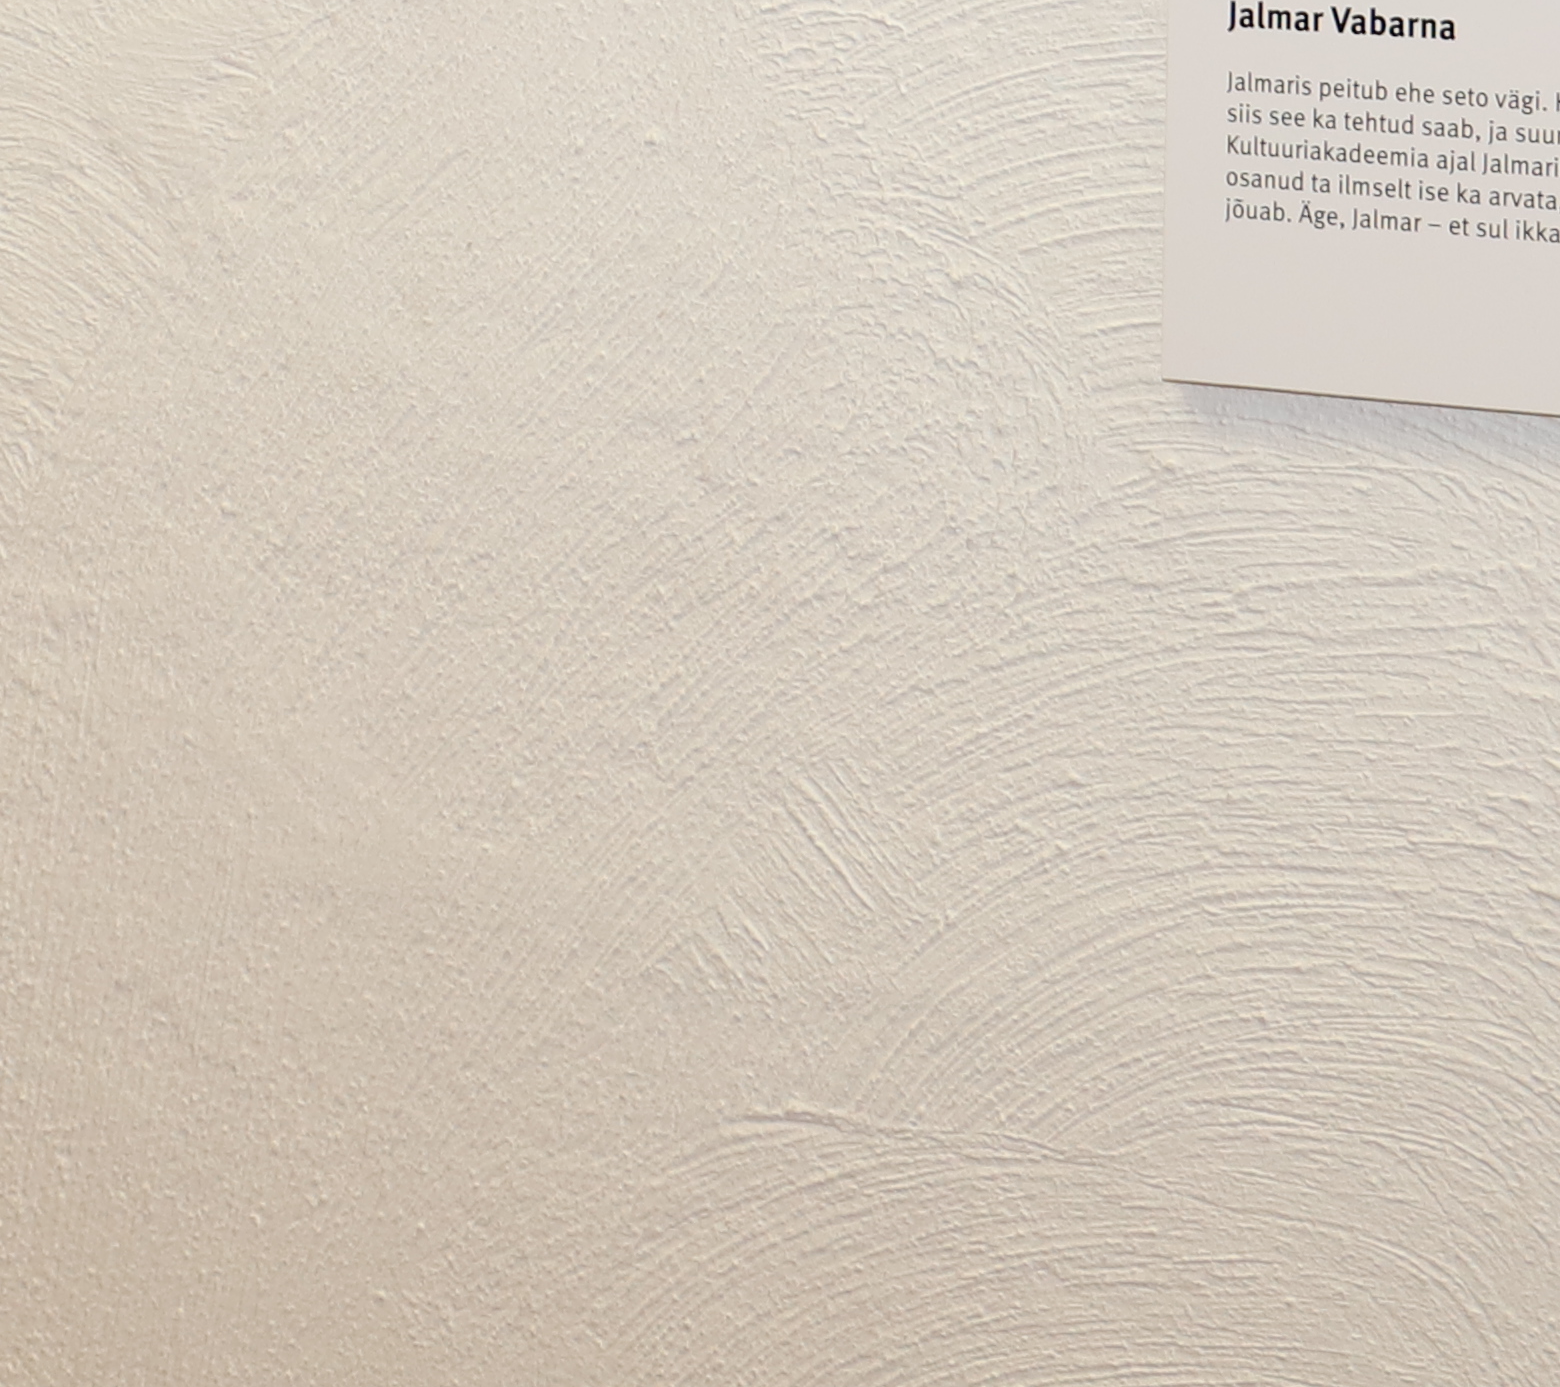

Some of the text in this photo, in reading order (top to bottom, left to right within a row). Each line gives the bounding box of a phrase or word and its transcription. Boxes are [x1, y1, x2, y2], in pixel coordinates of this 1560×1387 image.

[1226, 0, 1457, 41] Jalmar Vabarna
[1225, 70, 1313, 97] Jalmaris
[1318, 77, 1389, 103] peitub
[1394, 80, 1436, 105] ehe
[1441, 87, 1489, 109] seto
[1494, 88, 1549, 116] vägi.
[1226, 101, 1263, 126] siis
[1268, 109, 1307, 128] see
[1312, 106, 1338, 131] ka
[1343, 109, 1415, 136] tehtud
[1421, 116, 1482, 144] saab,
[1487, 118, 1509, 146] ja
[1226, 133, 1430, 170] Kultuuriakadeemia
[1435, 148, 1477, 176] ajal
[1225, 168, 1305, 192] osanud
[1310, 172, 1332, 195] ta
[1338, 172, 1413, 201] ilmselt
[1418, 178, 1450, 203] ise
[1456, 180, 1482, 206] ka
[1224, 196, 1293, 224] jõuab.
[1297, 198, 1346, 230] Äge,
[1351, 206, 1423, 233] Jalmar
[1448, 216, 1470, 237] et
[1475, 216, 1509, 241] sul
